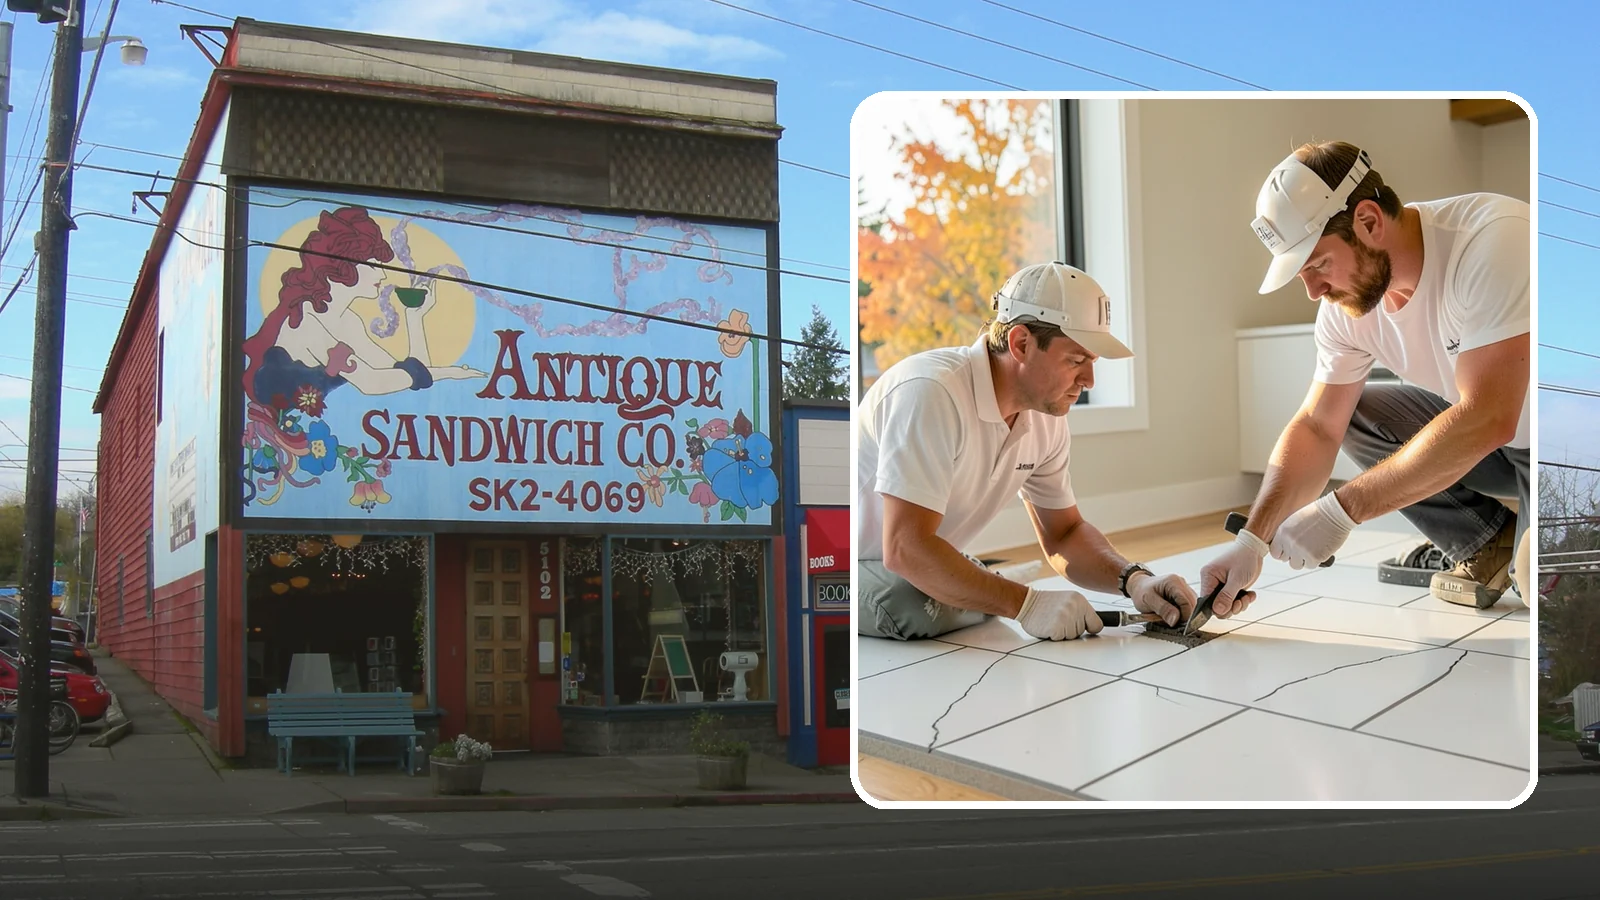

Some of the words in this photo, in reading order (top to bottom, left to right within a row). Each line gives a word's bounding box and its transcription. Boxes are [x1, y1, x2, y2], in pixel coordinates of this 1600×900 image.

[475, 329, 723, 421] ANTIQUE
[361, 409, 604, 467] SANDWICH
[617, 421, 685, 468] CO.
[469, 477, 645, 513] SK2-4069
[540, 542, 551, 599] 5102
[809, 555, 834, 568] BOOKS
